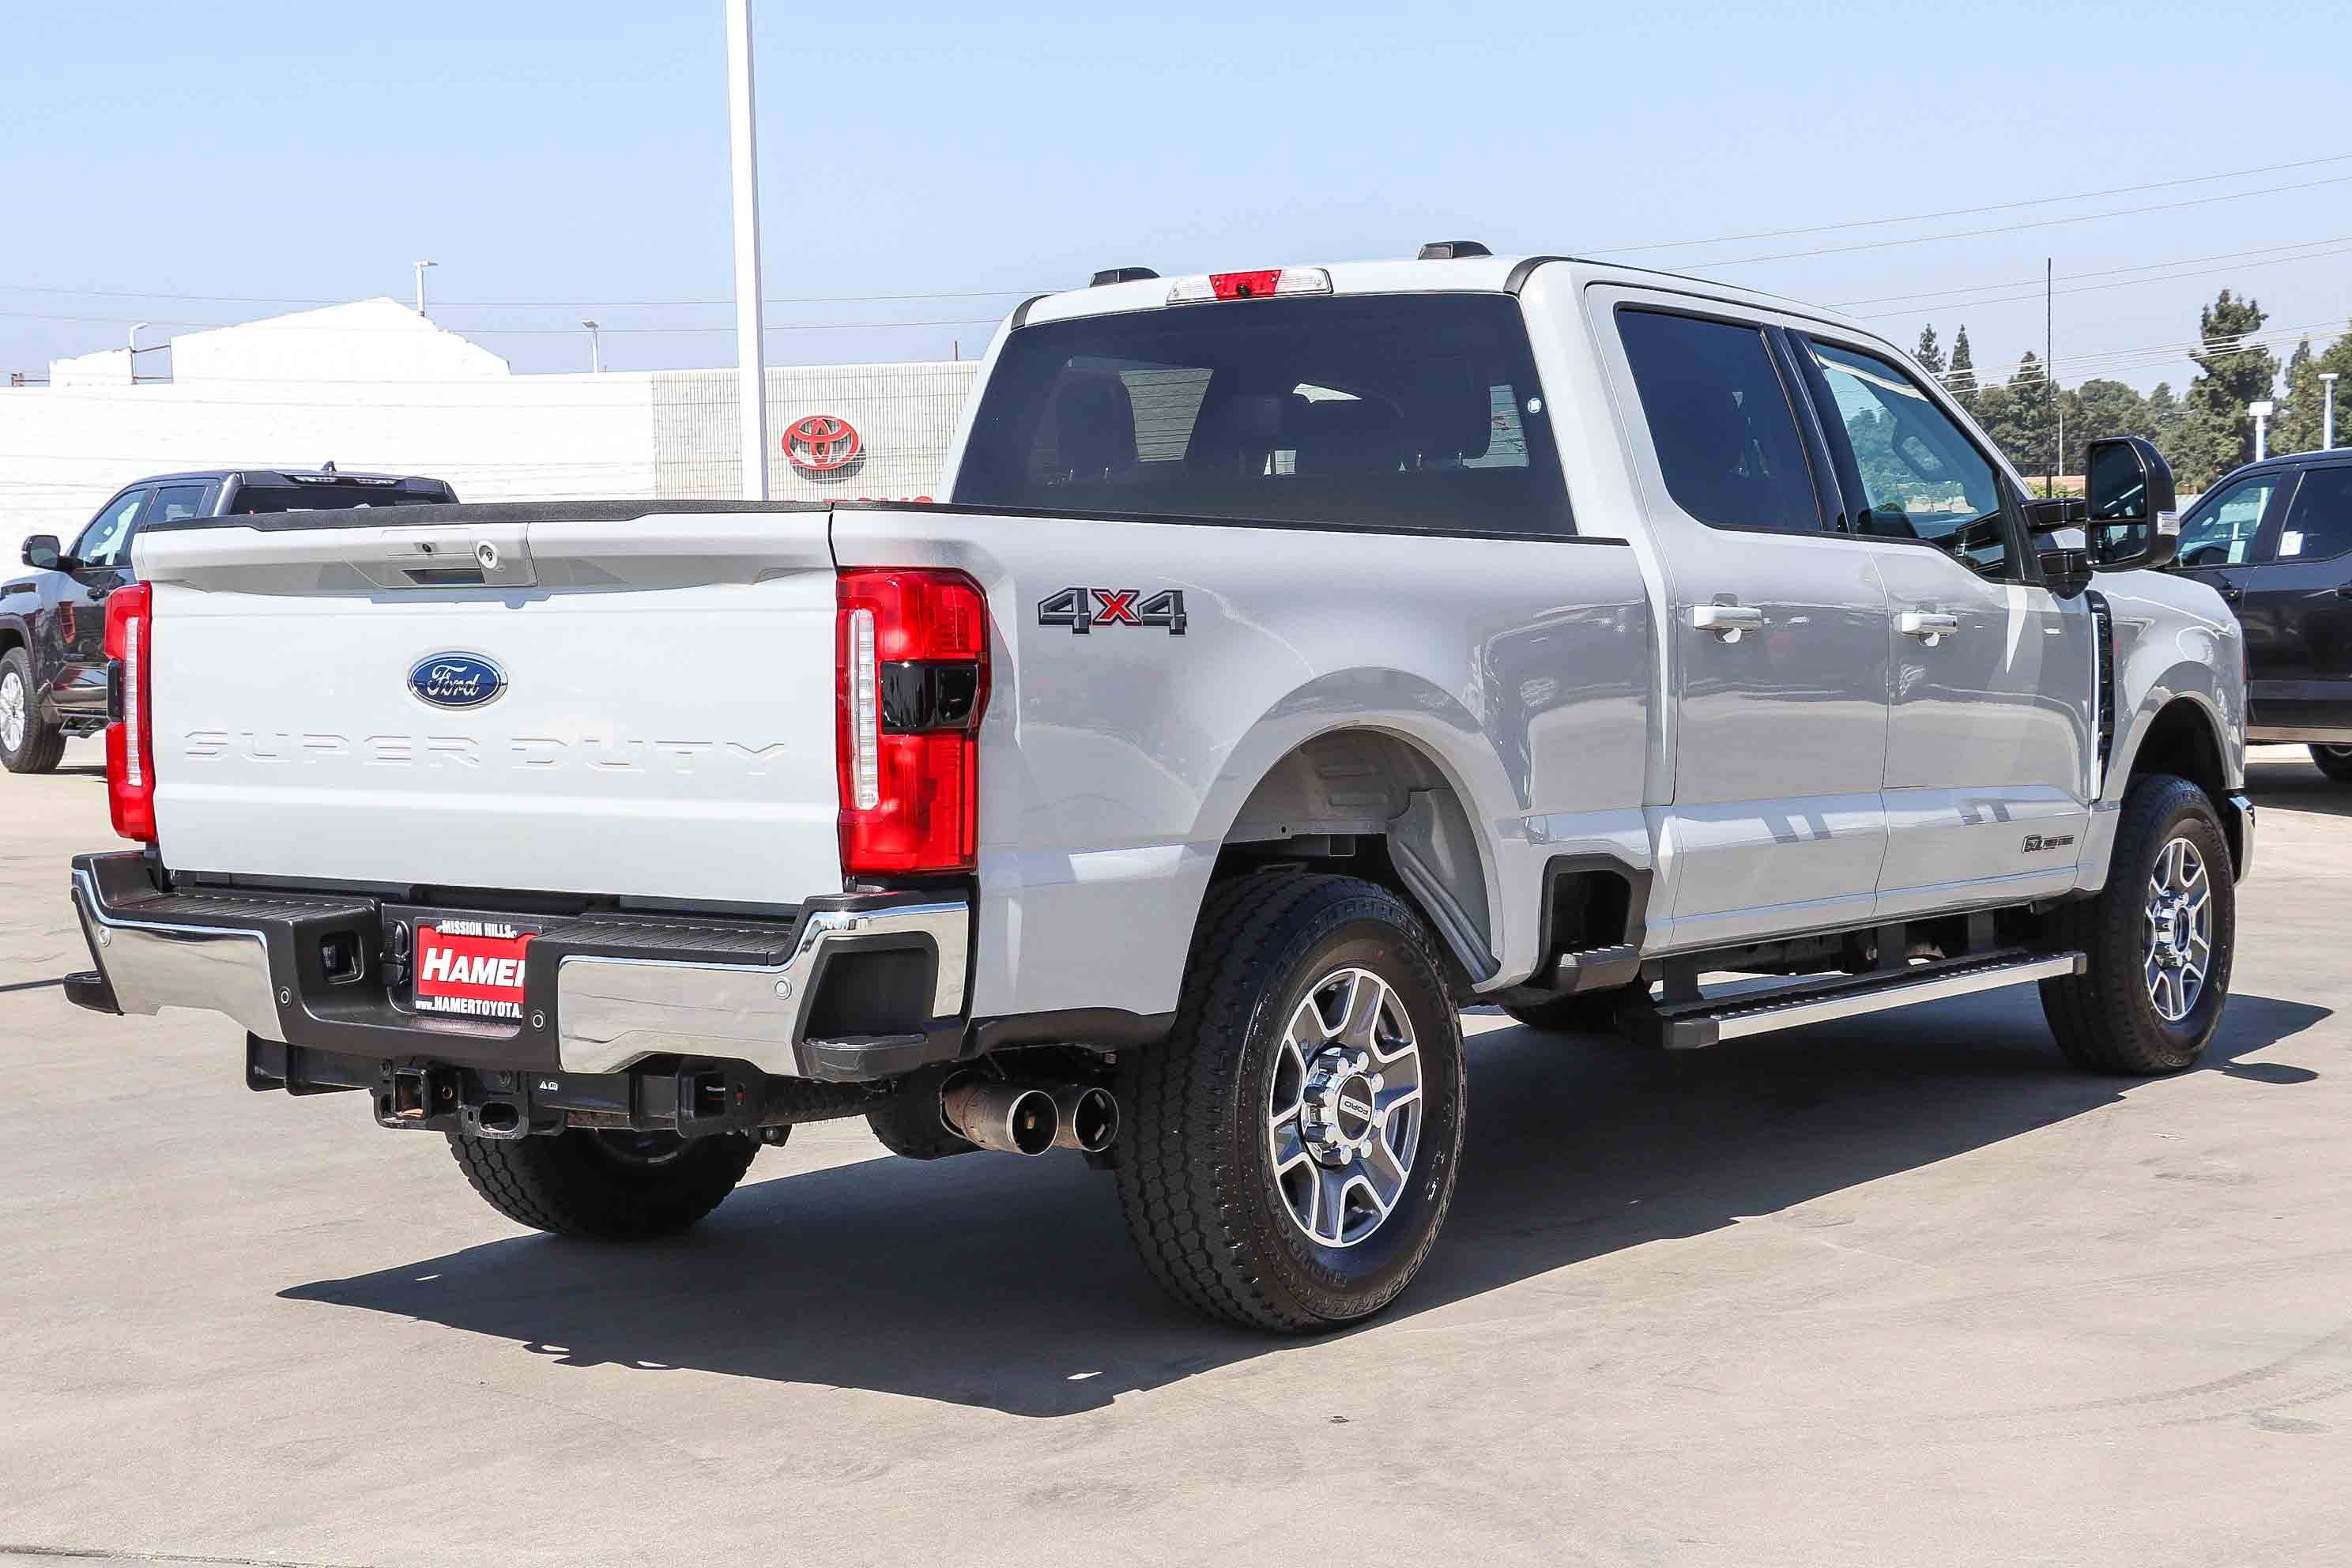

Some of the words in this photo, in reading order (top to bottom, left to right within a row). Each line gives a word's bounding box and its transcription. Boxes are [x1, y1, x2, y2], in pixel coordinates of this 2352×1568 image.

[427, 665, 481, 696] Ford
[184, 731, 481, 770] SUPER
[511, 737, 786, 776] DUTY
[442, 920, 482, 937] MISSION
[484, 923, 513, 939] HILLS
[1344, 1100, 1369, 1116] FORD
